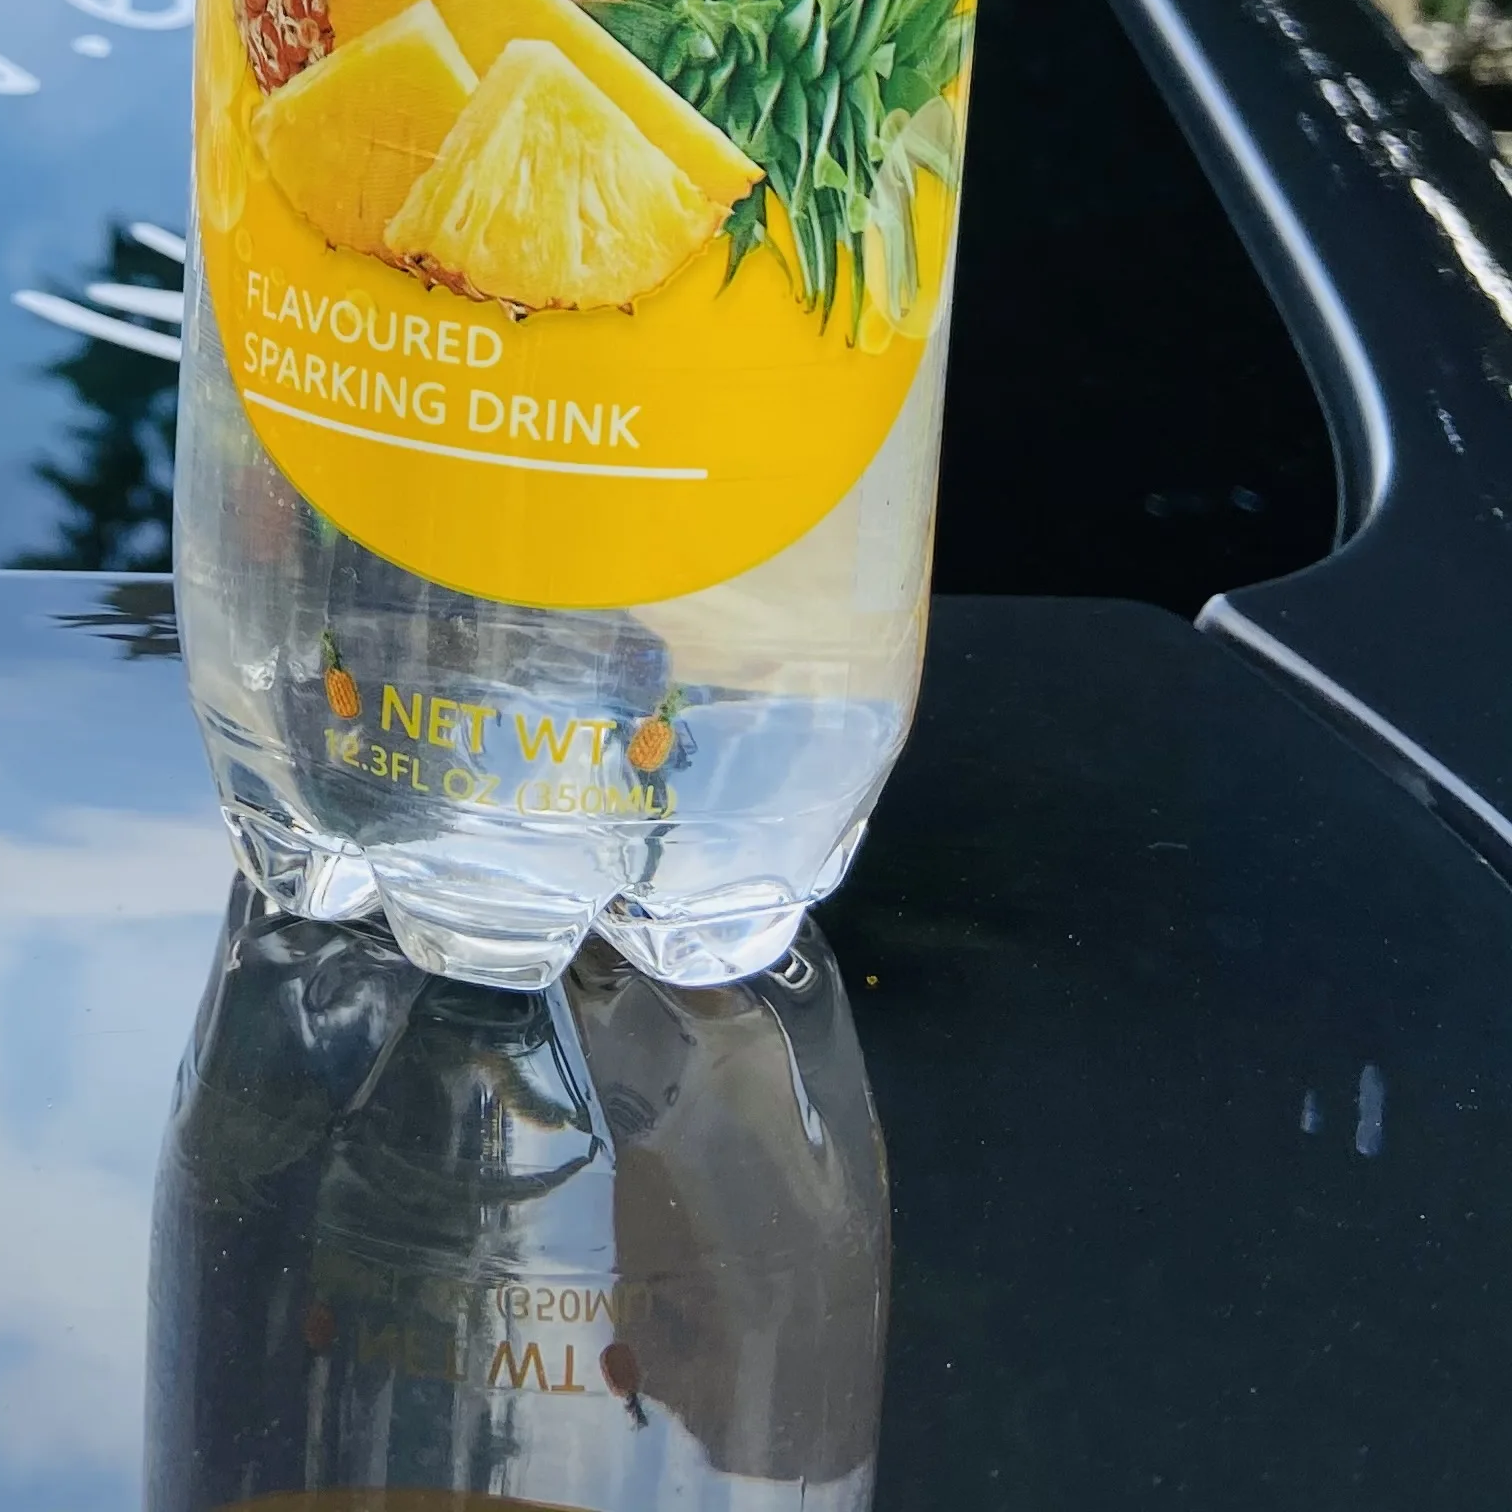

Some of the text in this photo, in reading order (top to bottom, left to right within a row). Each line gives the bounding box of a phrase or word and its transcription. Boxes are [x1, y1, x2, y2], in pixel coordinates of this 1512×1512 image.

[245, 270, 504, 369] FLAVOURED
[243, 331, 643, 449] SPARKING DRINK
[381, 684, 618, 766] NET WT
[443, 768, 502, 806] OZ
[516, 781, 678, 820] (350ML)
